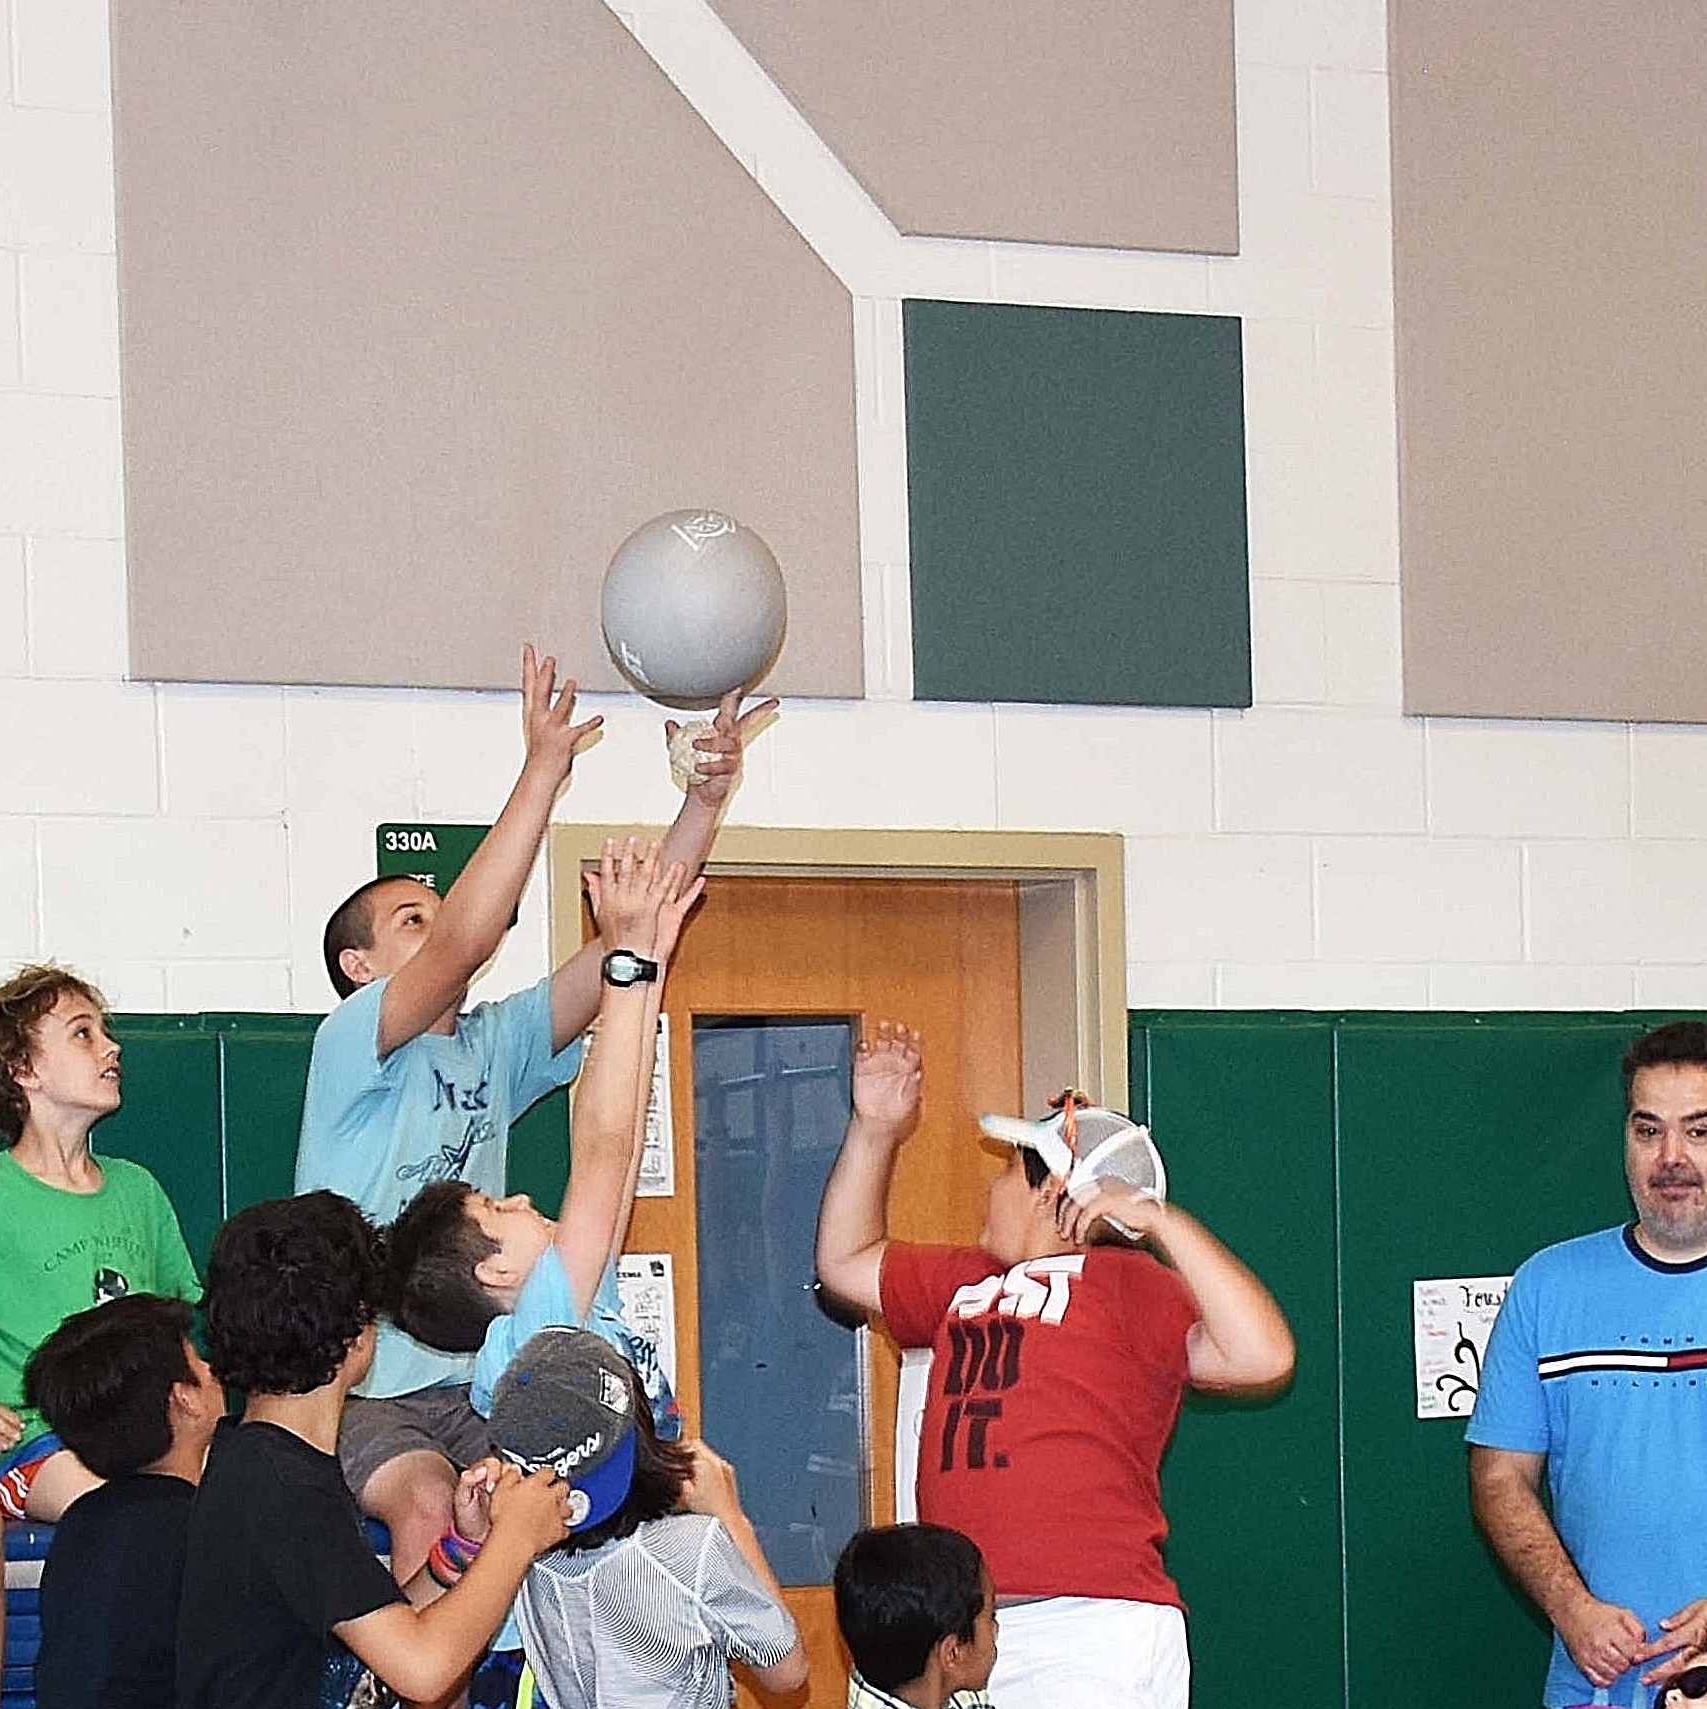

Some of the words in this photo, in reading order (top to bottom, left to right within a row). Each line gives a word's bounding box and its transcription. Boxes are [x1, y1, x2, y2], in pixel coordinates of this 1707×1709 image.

[385, 831, 437, 851] 330A
[943, 1316, 1025, 1396] DO
[940, 1398, 1010, 1473] IT.
